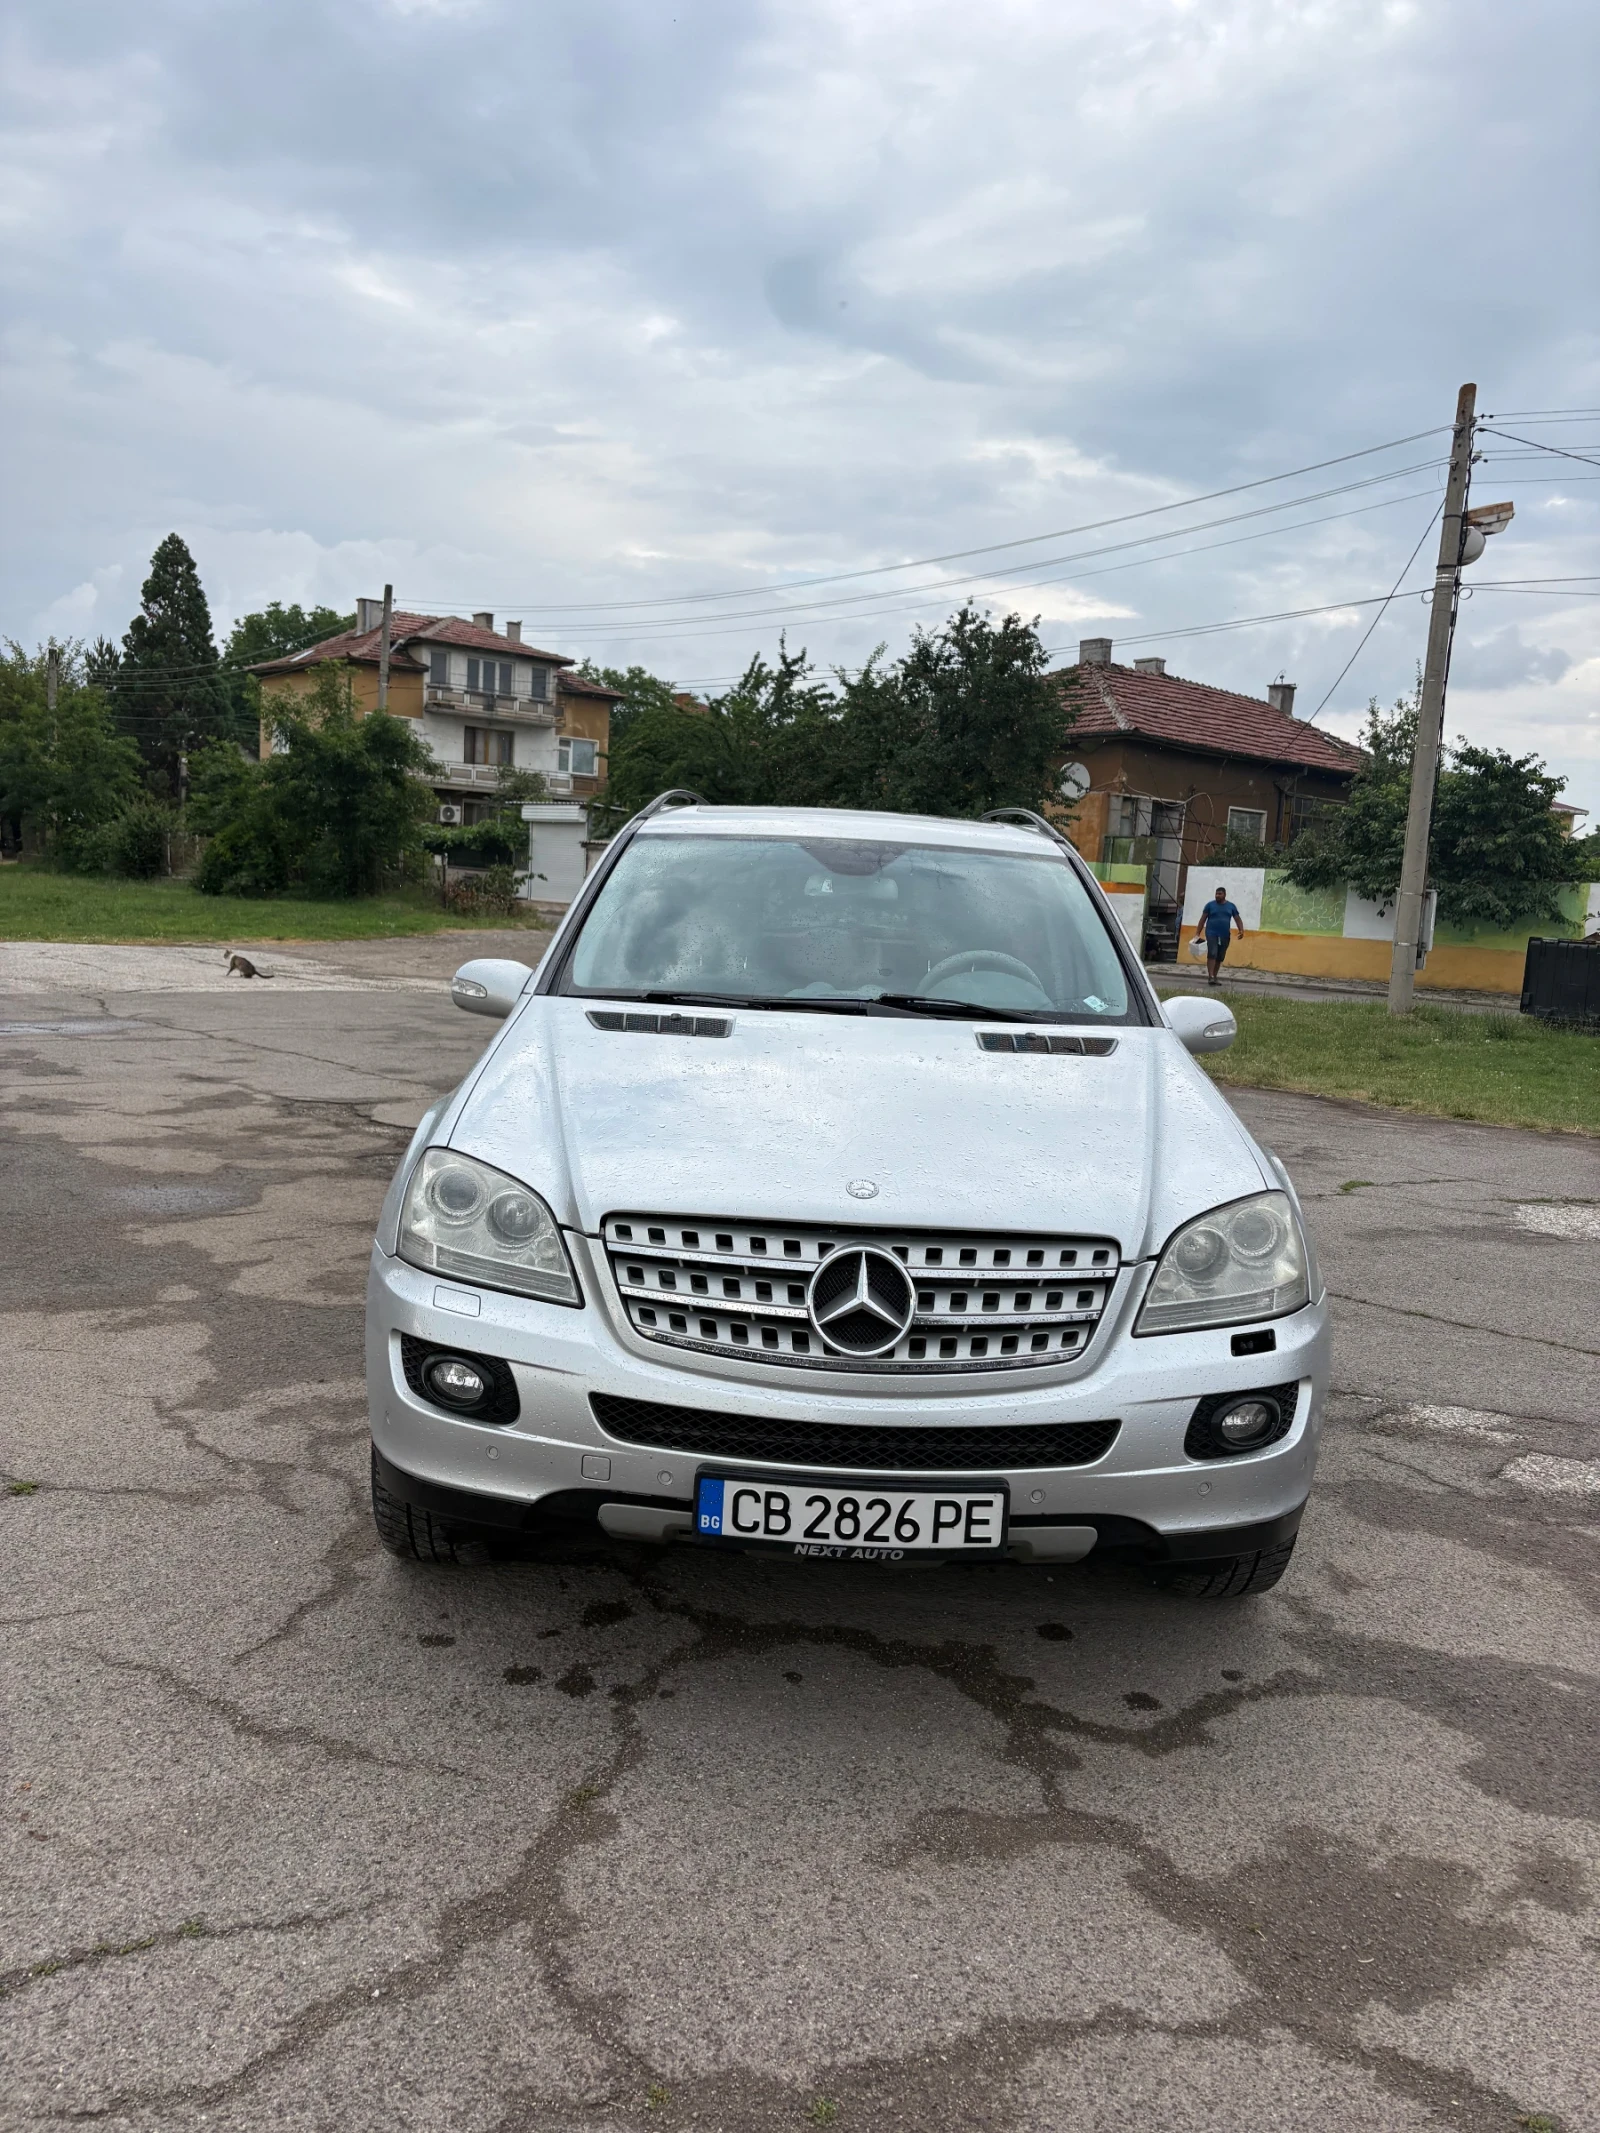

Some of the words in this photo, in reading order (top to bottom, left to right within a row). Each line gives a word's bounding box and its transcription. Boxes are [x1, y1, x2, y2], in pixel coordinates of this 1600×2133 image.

[700, 1514, 720, 1529] BG
[731, 1488, 792, 1535] CB
[803, 1494, 920, 1543] 2826
[932, 1499, 994, 1544] PE
[794, 1544, 847, 1557] NEXT
[850, 1548, 904, 1560] AUTO
